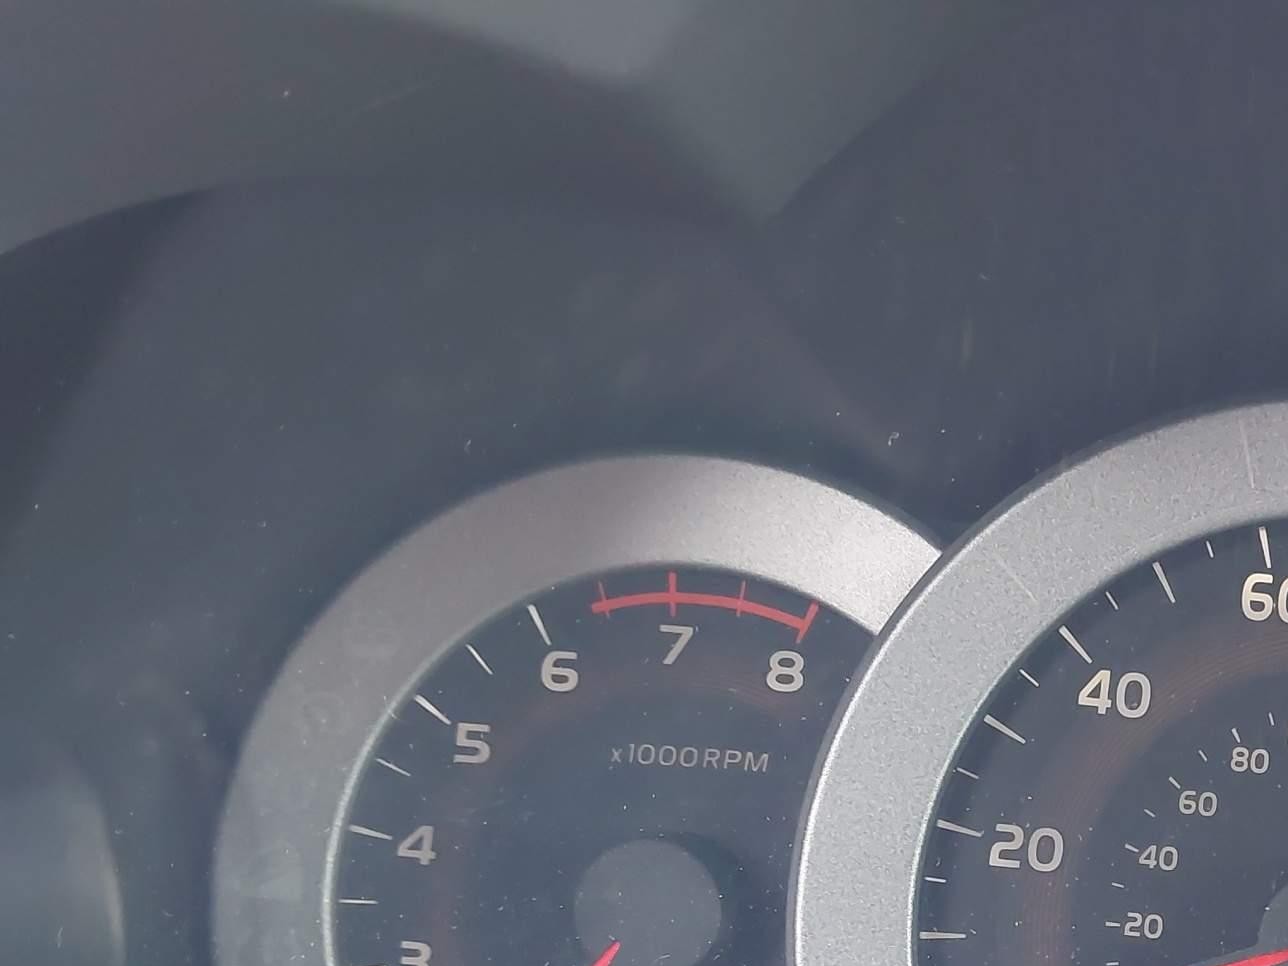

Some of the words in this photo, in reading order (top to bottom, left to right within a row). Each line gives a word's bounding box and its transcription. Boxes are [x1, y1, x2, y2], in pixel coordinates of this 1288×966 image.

[660, 625, 693, 664] 7
[541, 651, 578, 691] 6
[767, 651, 804, 692] 8
[1078, 670, 1150, 718] 40
[454, 723, 490, 763] 5
[1231, 747, 1269, 773] 80
[1179, 791, 1217, 816] 60
[397, 826, 435, 865] 4
[989, 824, 1063, 871] 20
[1139, 845, 1178, 870] 40
[1124, 912, 1162, 938] 20
